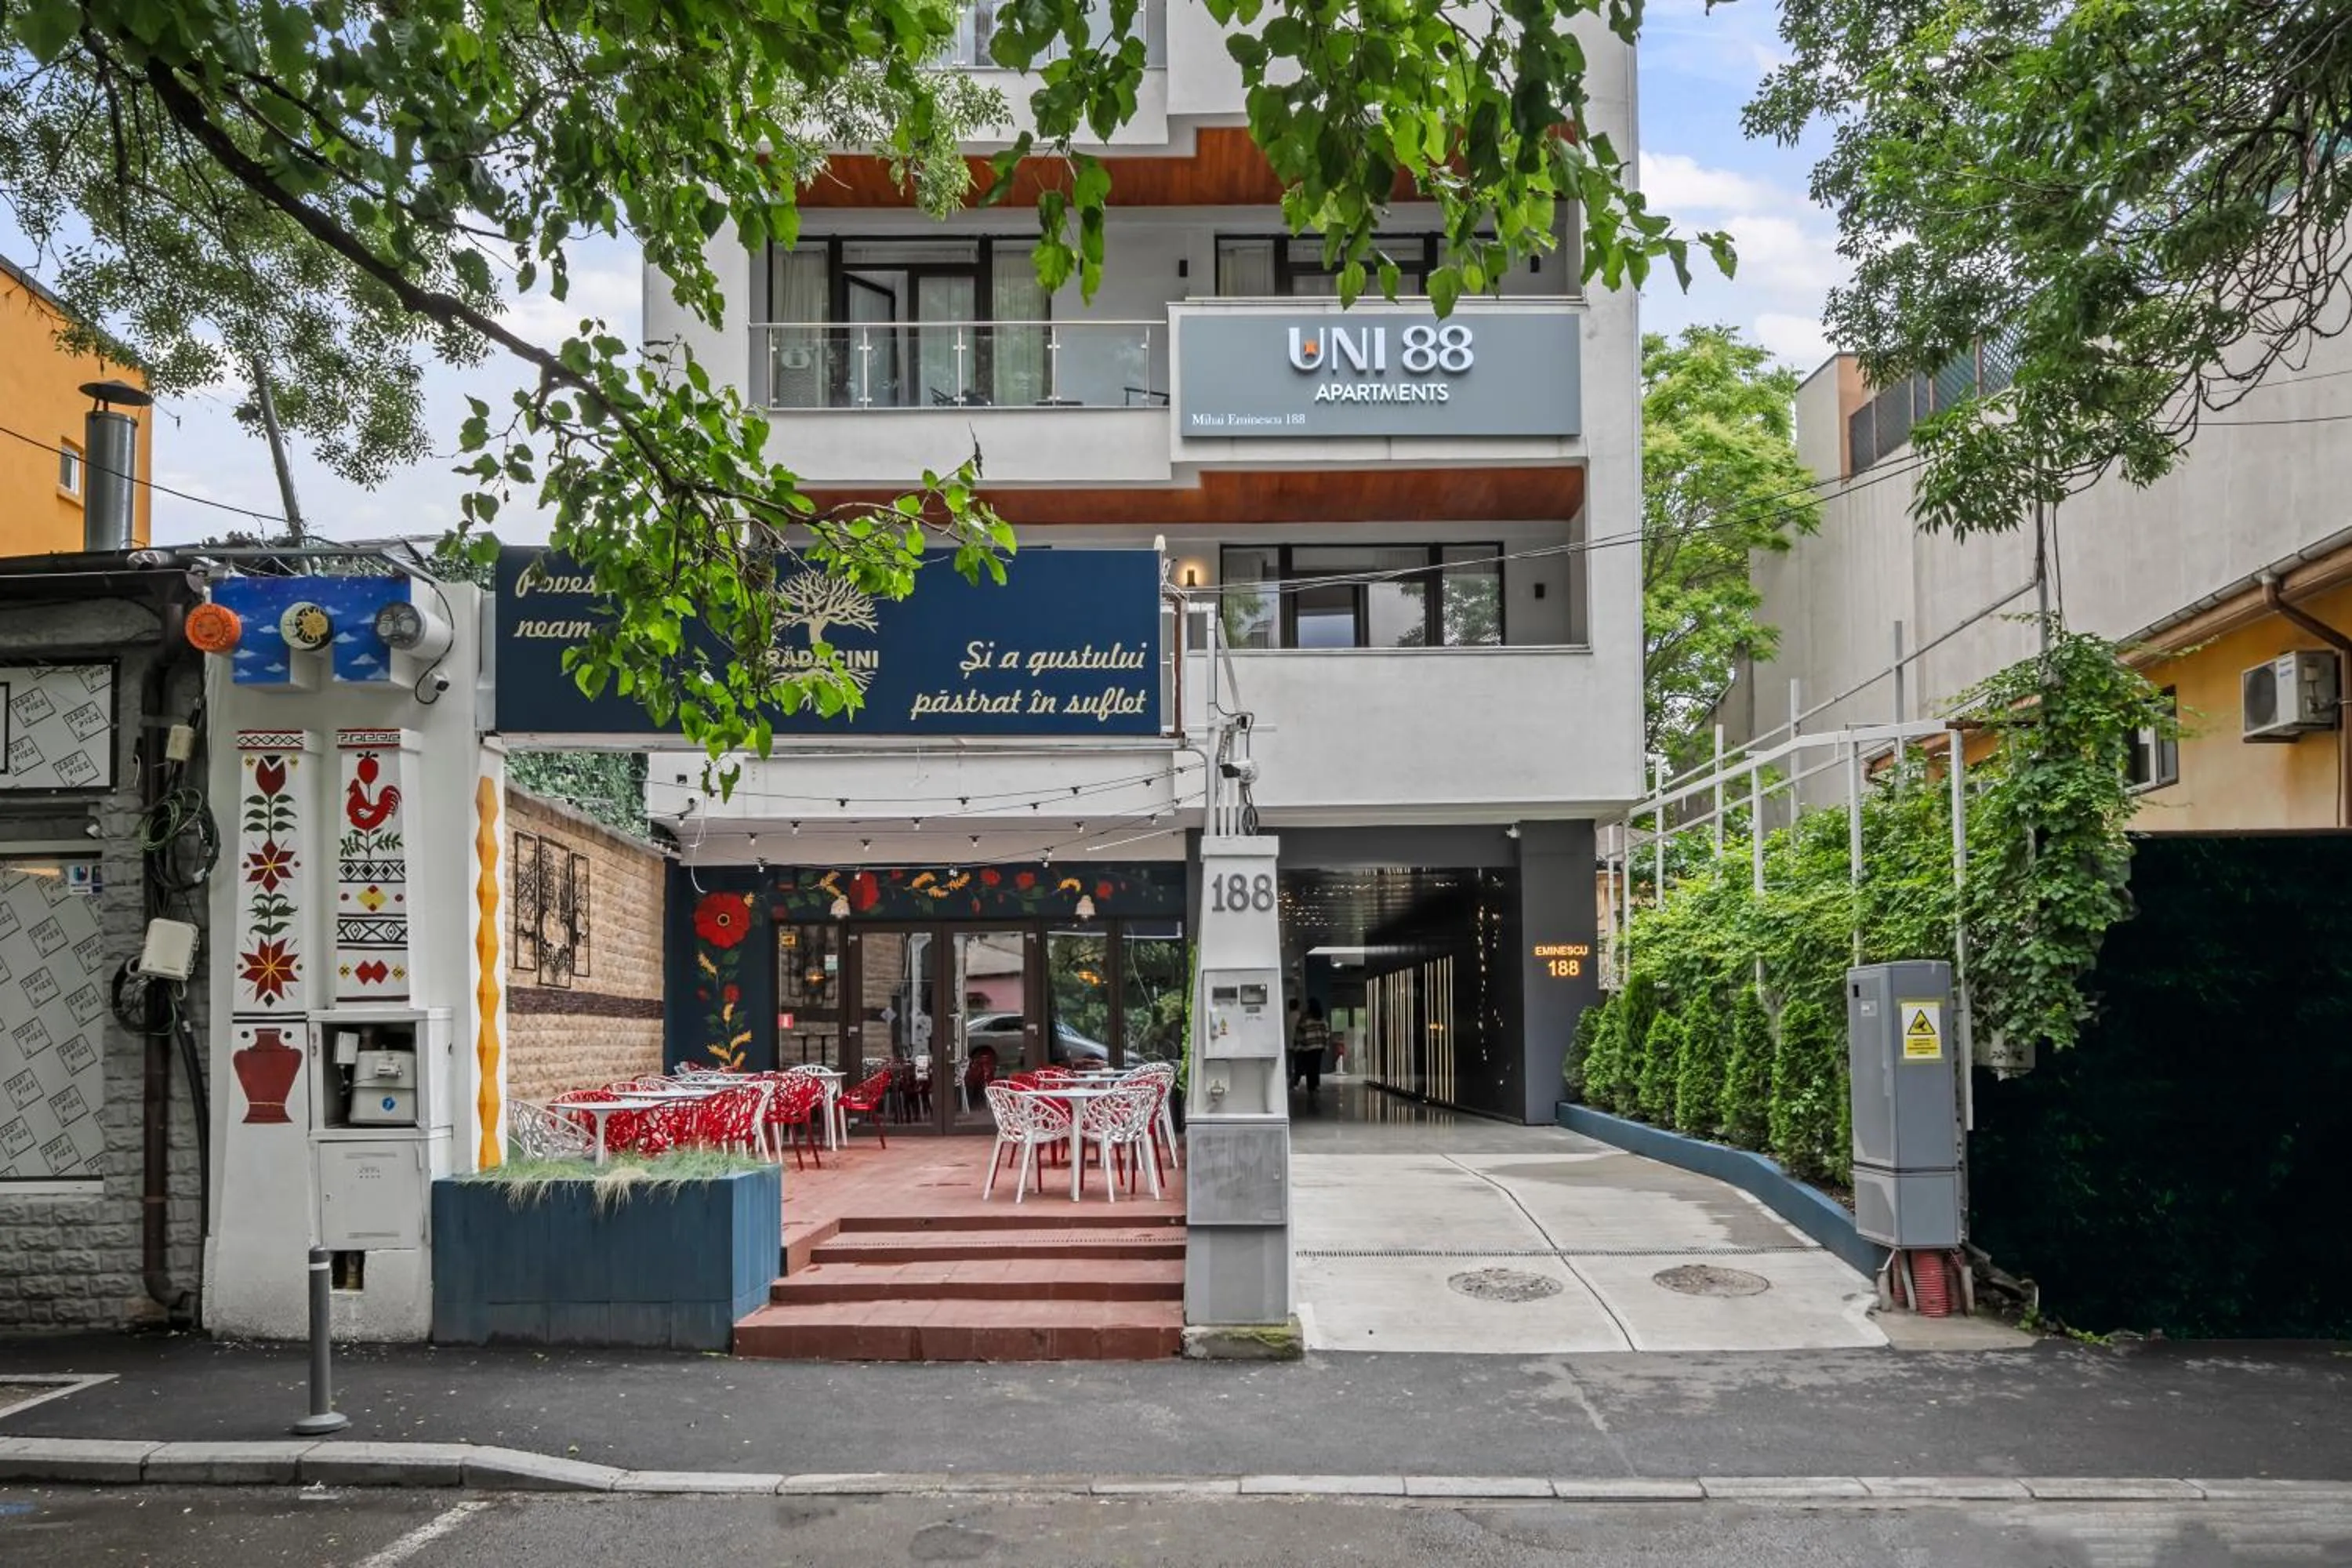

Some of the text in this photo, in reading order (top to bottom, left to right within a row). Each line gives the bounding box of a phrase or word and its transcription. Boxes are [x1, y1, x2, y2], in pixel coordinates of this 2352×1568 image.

[1288, 325, 1475, 372] UNI 88
[1315, 383, 1450, 402] APARTMENTS
[1192, 413, 1305, 426] Mihai Eminescu 188
[960, 641, 1148, 679] Și a gustului
[910, 687, 1146, 721] păstrat în suflet
[1211, 873, 1276, 913] 188
[1534, 946, 1588, 956] EMINESCU
[1548, 960, 1580, 977] 188
